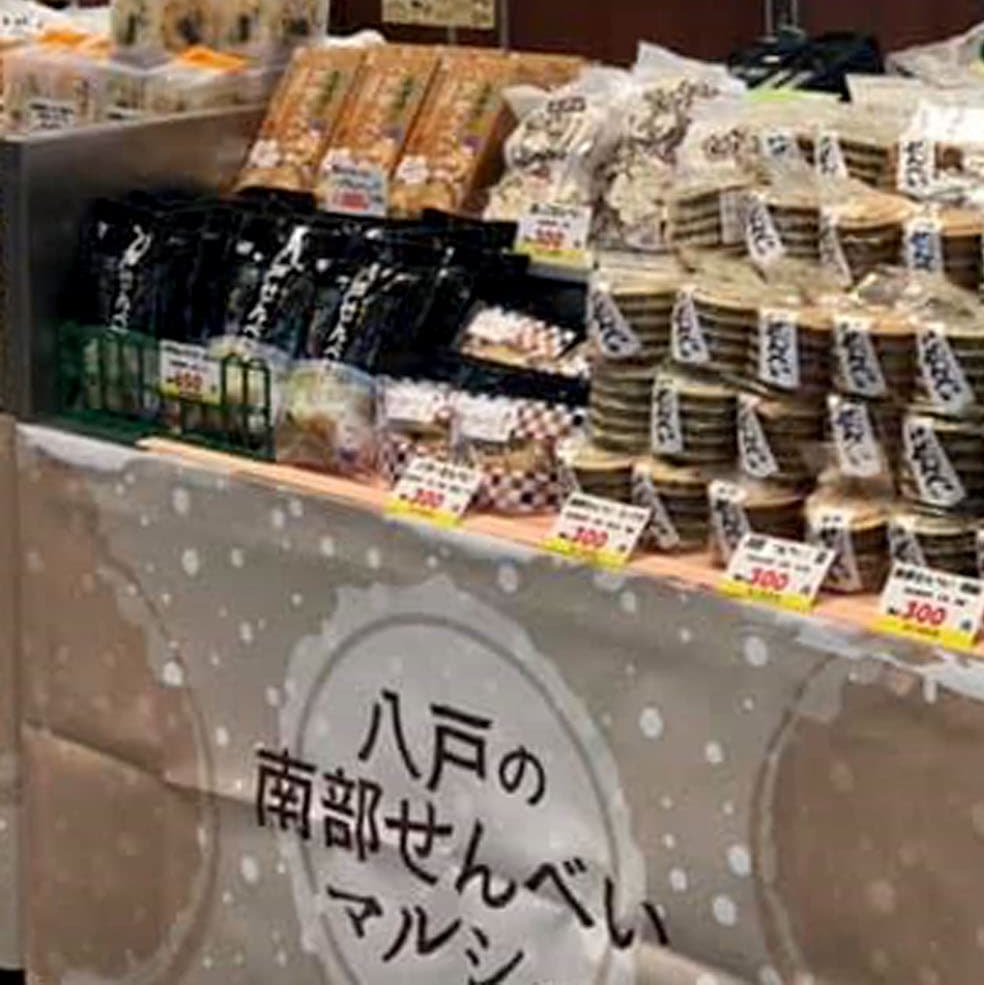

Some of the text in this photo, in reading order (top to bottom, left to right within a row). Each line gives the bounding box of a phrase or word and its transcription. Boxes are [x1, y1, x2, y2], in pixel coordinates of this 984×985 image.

[747, 564, 789, 592] 300
[903, 599, 946, 626] 300
[357, 687, 547, 806] 八戸の
[255, 747, 670, 950] 南部せんべい
